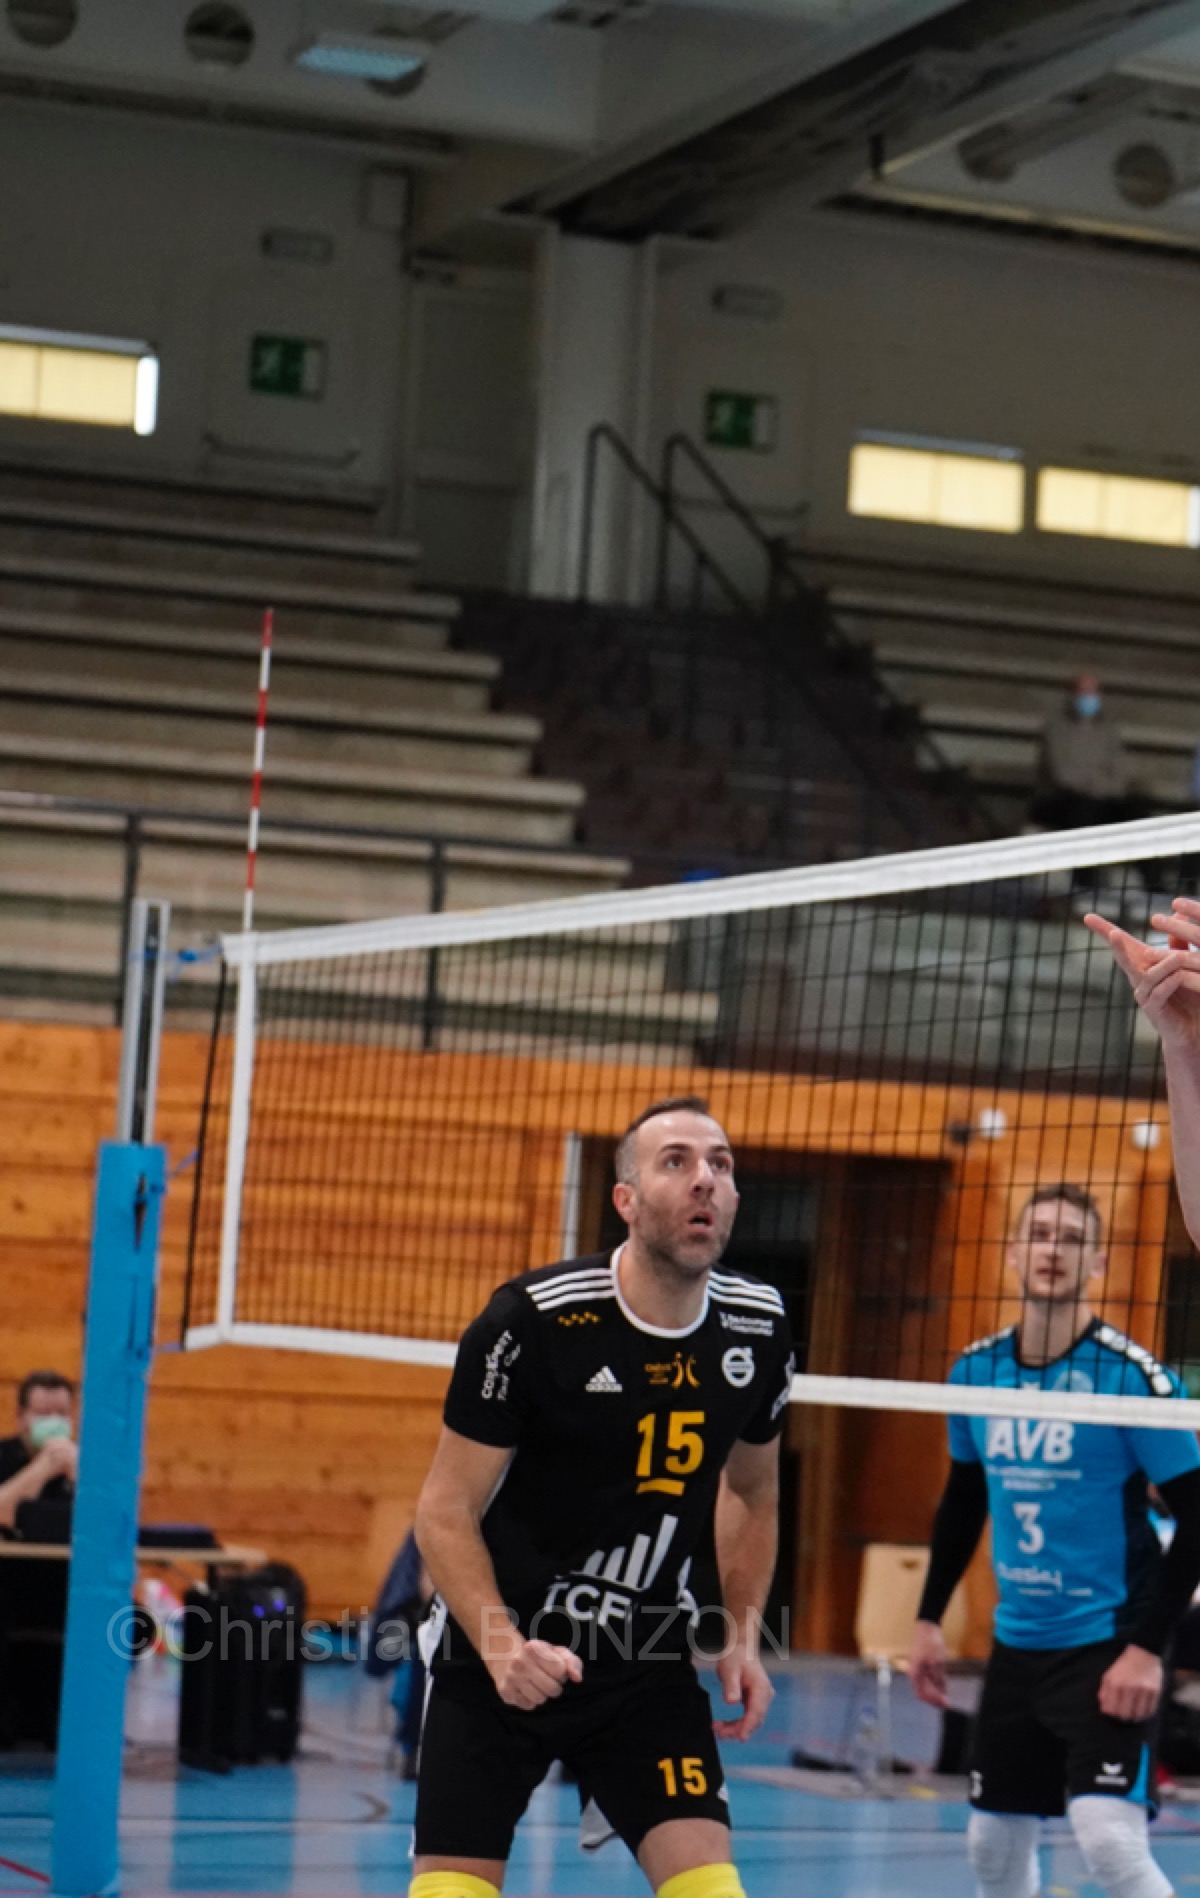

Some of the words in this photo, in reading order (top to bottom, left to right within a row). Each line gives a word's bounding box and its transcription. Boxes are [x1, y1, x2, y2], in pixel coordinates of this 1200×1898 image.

[636, 1410, 705, 1477] 15
[985, 1418, 1075, 1463] AVB
[1012, 1501, 1045, 1555] 3
[657, 1757, 708, 1797] 15
